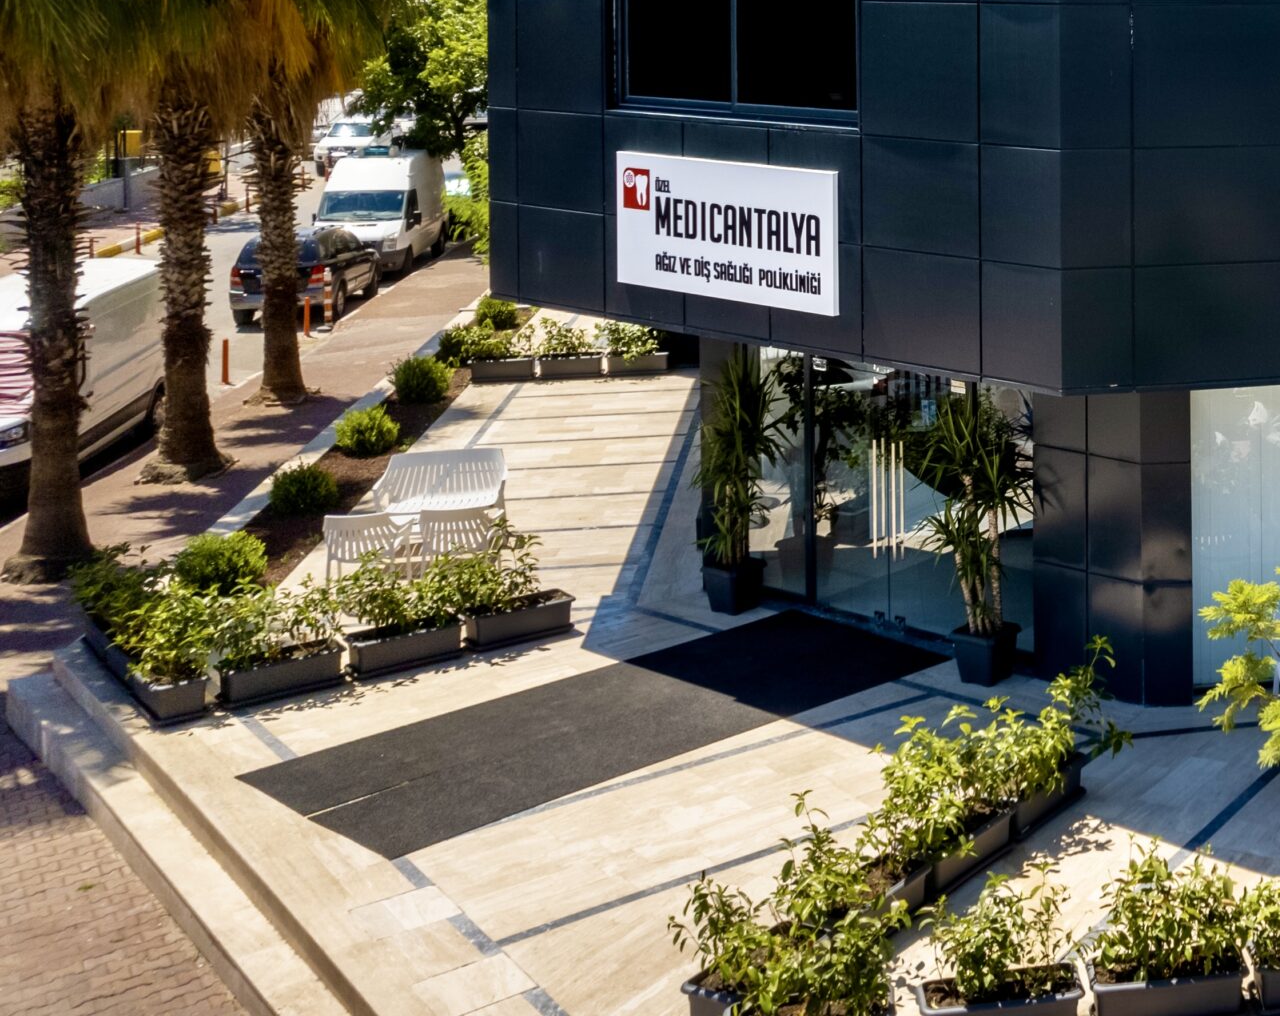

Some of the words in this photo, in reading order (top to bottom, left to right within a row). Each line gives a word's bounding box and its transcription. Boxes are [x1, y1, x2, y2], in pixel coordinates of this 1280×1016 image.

[655, 176, 671, 193] ÖZEL
[655, 196, 821, 257] MEDICANTALYA
[655, 251, 677, 273] AĞIZ
[679, 256, 692, 276] VE
[694, 256, 711, 283] DİŞ
[713, 260, 753, 285] SAĞLIĞI
[758, 267, 821, 295] POLİKLİNİĞİ
